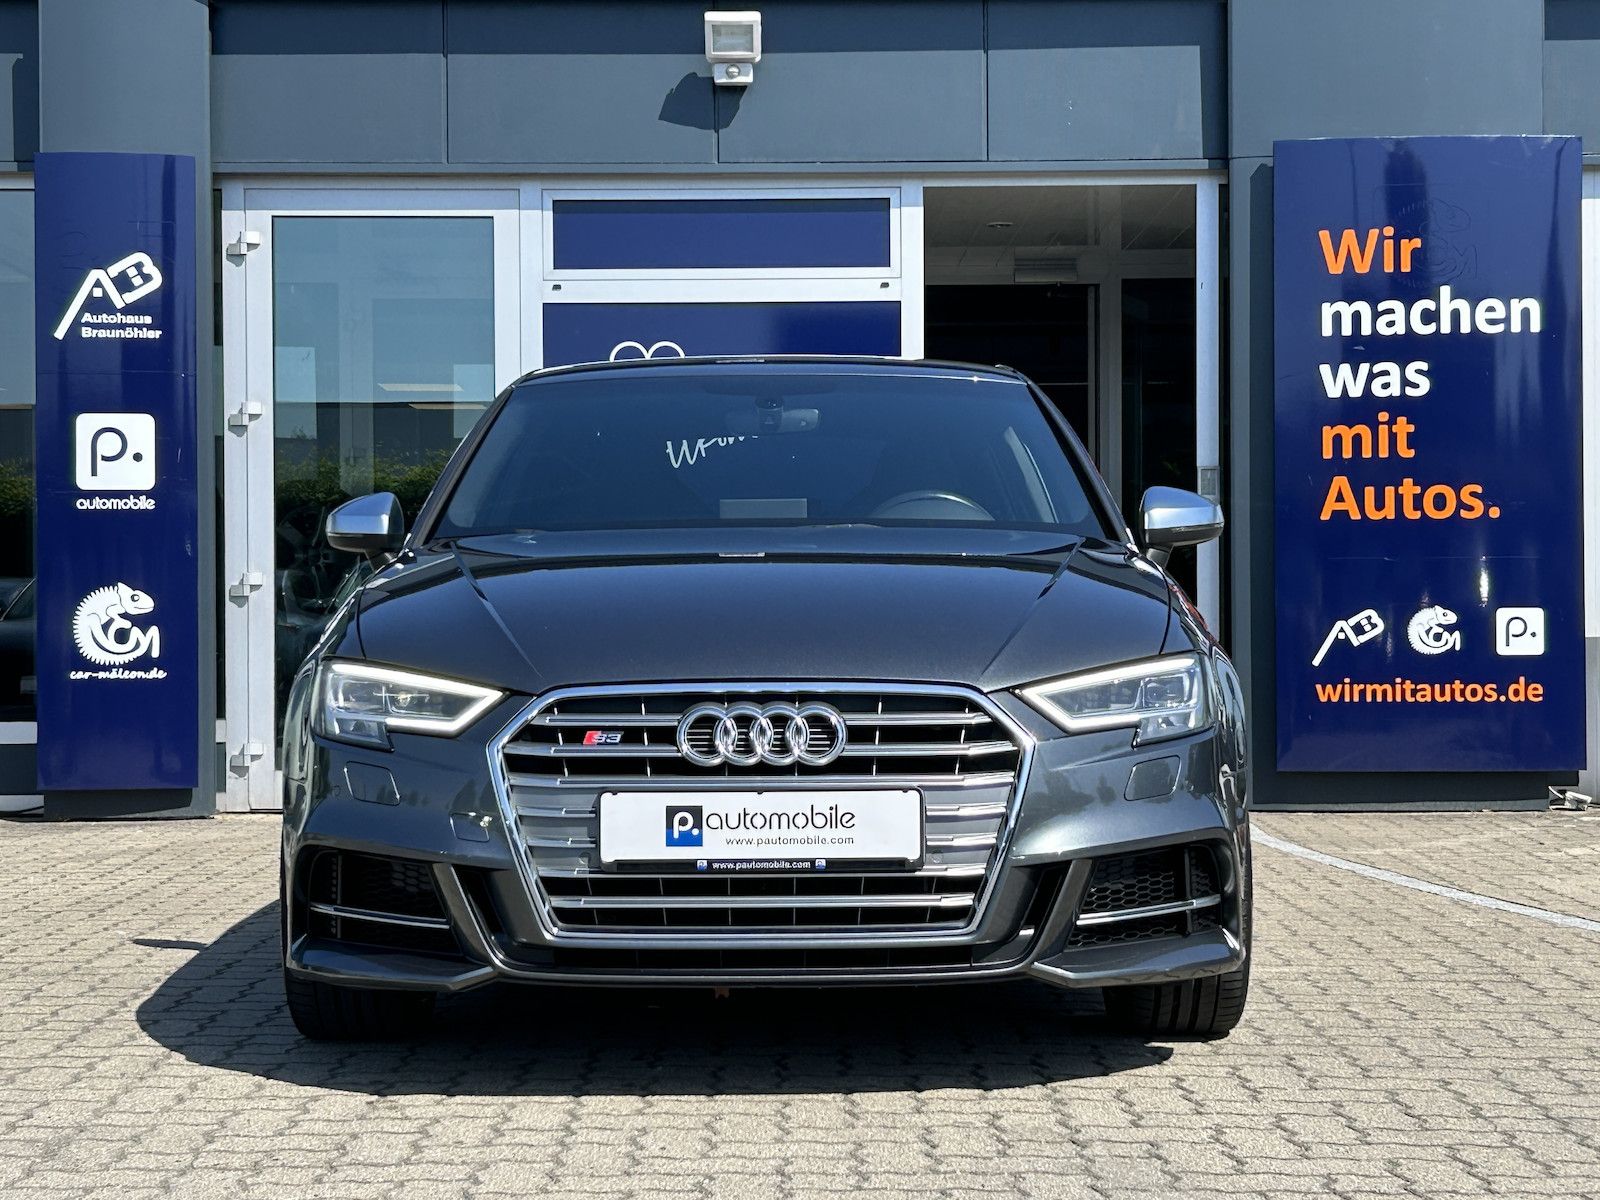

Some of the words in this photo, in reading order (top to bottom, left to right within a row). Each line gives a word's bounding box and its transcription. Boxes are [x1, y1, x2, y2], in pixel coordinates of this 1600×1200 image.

[1318, 226, 1422, 275] Wir
[81, 312, 153, 325] Autohaus
[1320, 285, 1541, 337] machen
[81, 326, 163, 339] Braunöhler
[1318, 360, 1431, 398] was
[1321, 411, 1416, 459] mit
[75, 494, 156, 510] automobile
[1319, 475, 1501, 521] Autos.
[1315, 676, 1544, 703] wirmitautos.de
[705, 804, 856, 830] automobile
[725, 835, 854, 846] www.pautomobile.com
[712, 861, 811, 870] www.pautomobile.com
